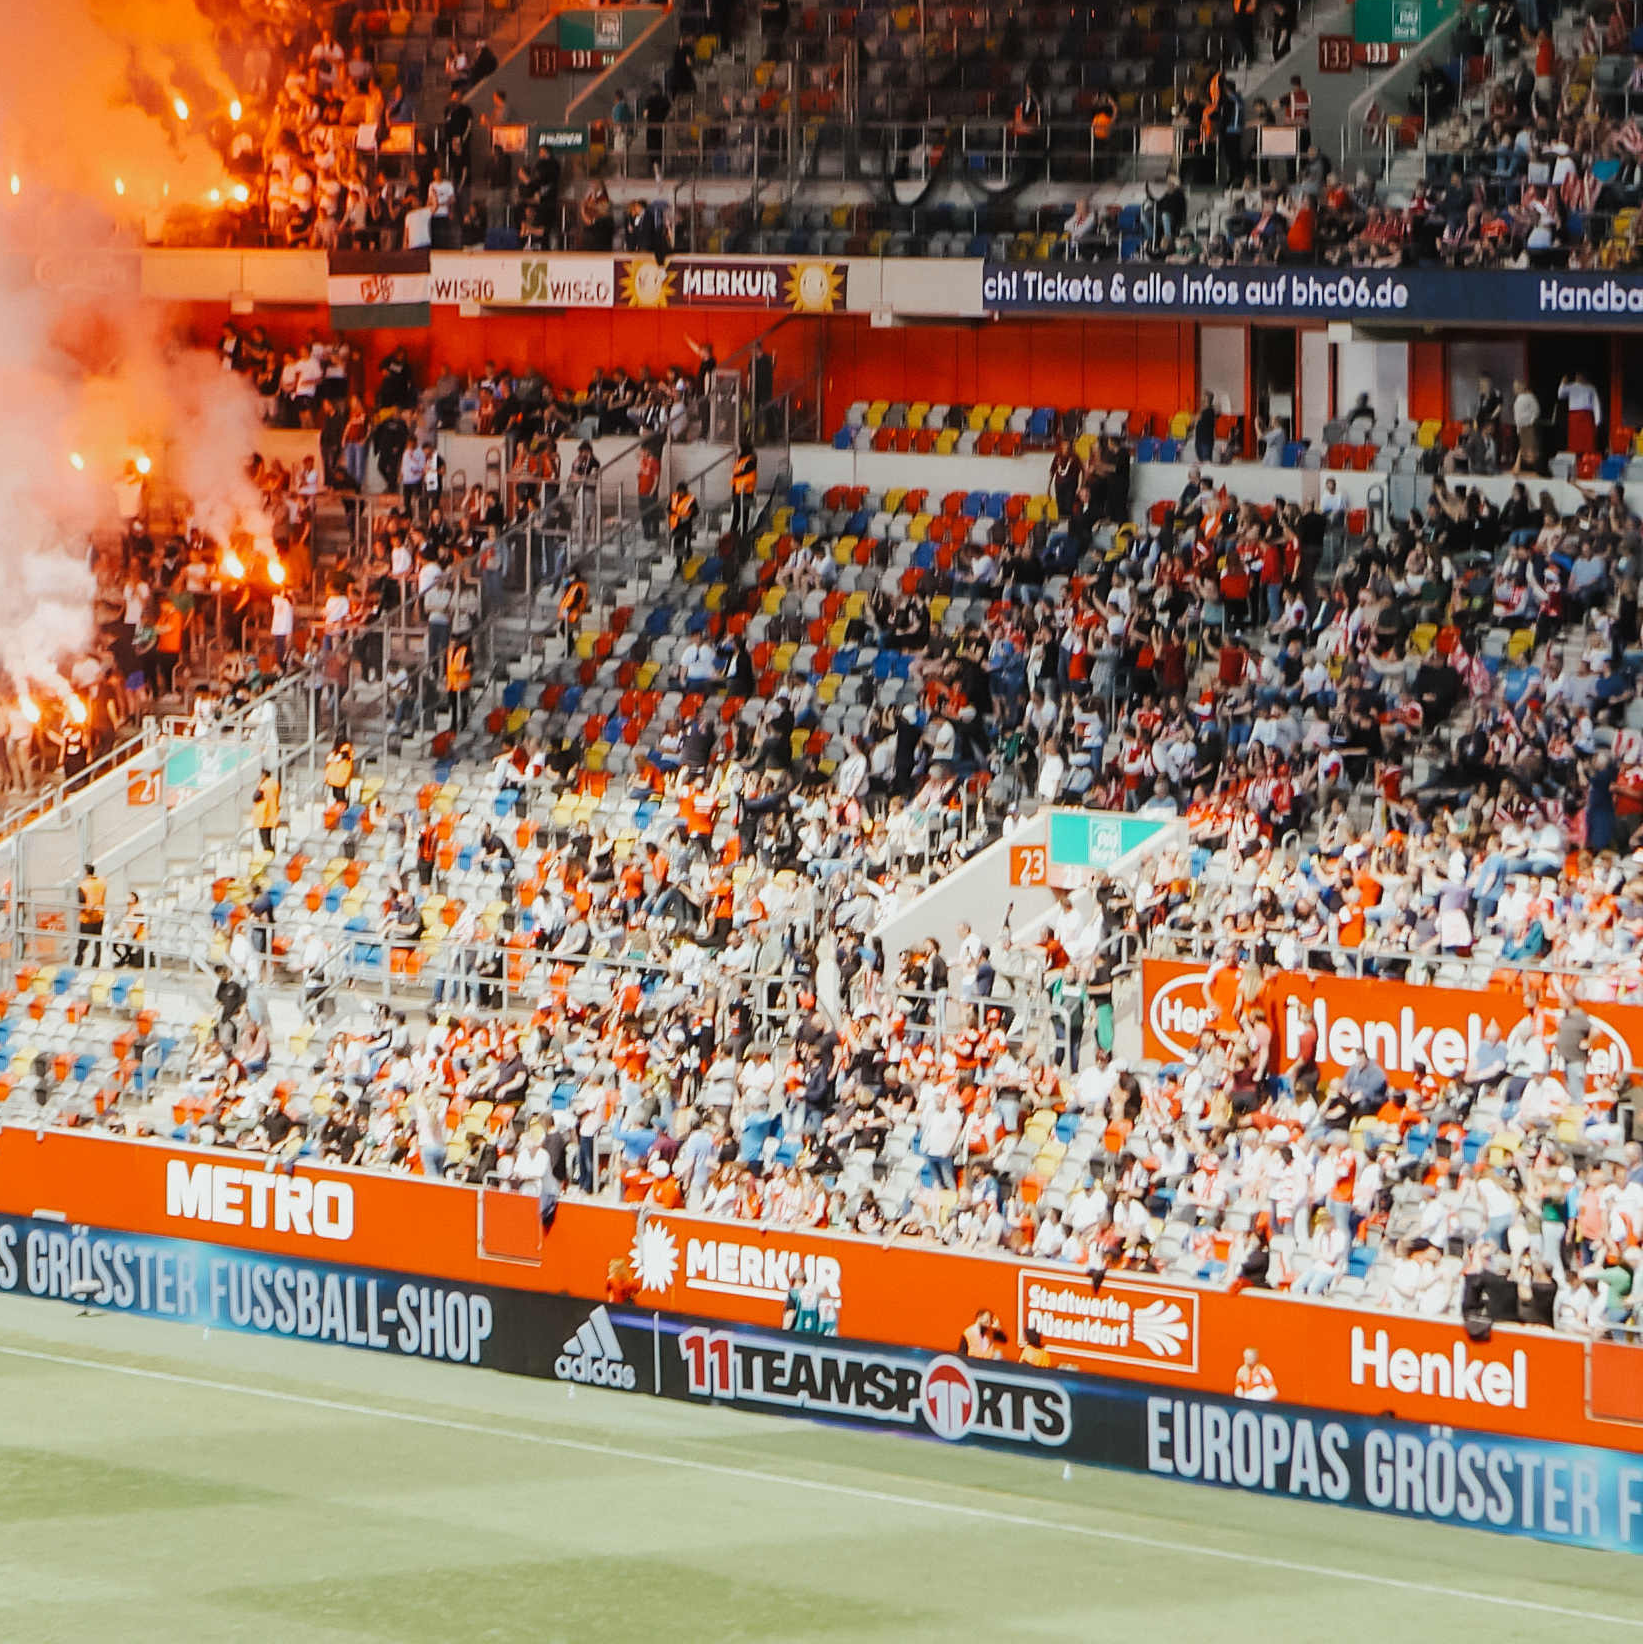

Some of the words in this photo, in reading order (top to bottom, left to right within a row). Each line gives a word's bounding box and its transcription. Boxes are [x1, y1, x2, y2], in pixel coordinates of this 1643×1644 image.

[1323, 41, 1351, 69] 133
[1366, 42, 1389, 64] 133
[682, 267, 777, 297] MERKUR
[1023, 272, 1103, 303] Tickets
[1109, 273, 1126, 302] &
[1133, 274, 1176, 305] alle
[1182, 274, 1239, 306] Infos
[1246, 274, 1286, 307] auf
[1292, 275, 1408, 309] bhc06.de
[1019, 848, 1046, 887] 23
[1286, 994, 1482, 1078] Henkel
[167, 1159, 355, 1240] METRO
[685, 1237, 842, 1299] MERKUR
[25, 1225, 199, 1318] GRÖSSTER
[211, 1258, 494, 1365] FUSSBALL-SHOP
[1028, 1283, 1131, 1322] Stadtwerke
[553, 1353, 637, 1391] adidas
[1350, 1325, 1527, 1410] Henkel
[1147, 1396, 1350, 1502] EUROPAS
[1364, 1424, 1601, 1540] GRÖSSTER
